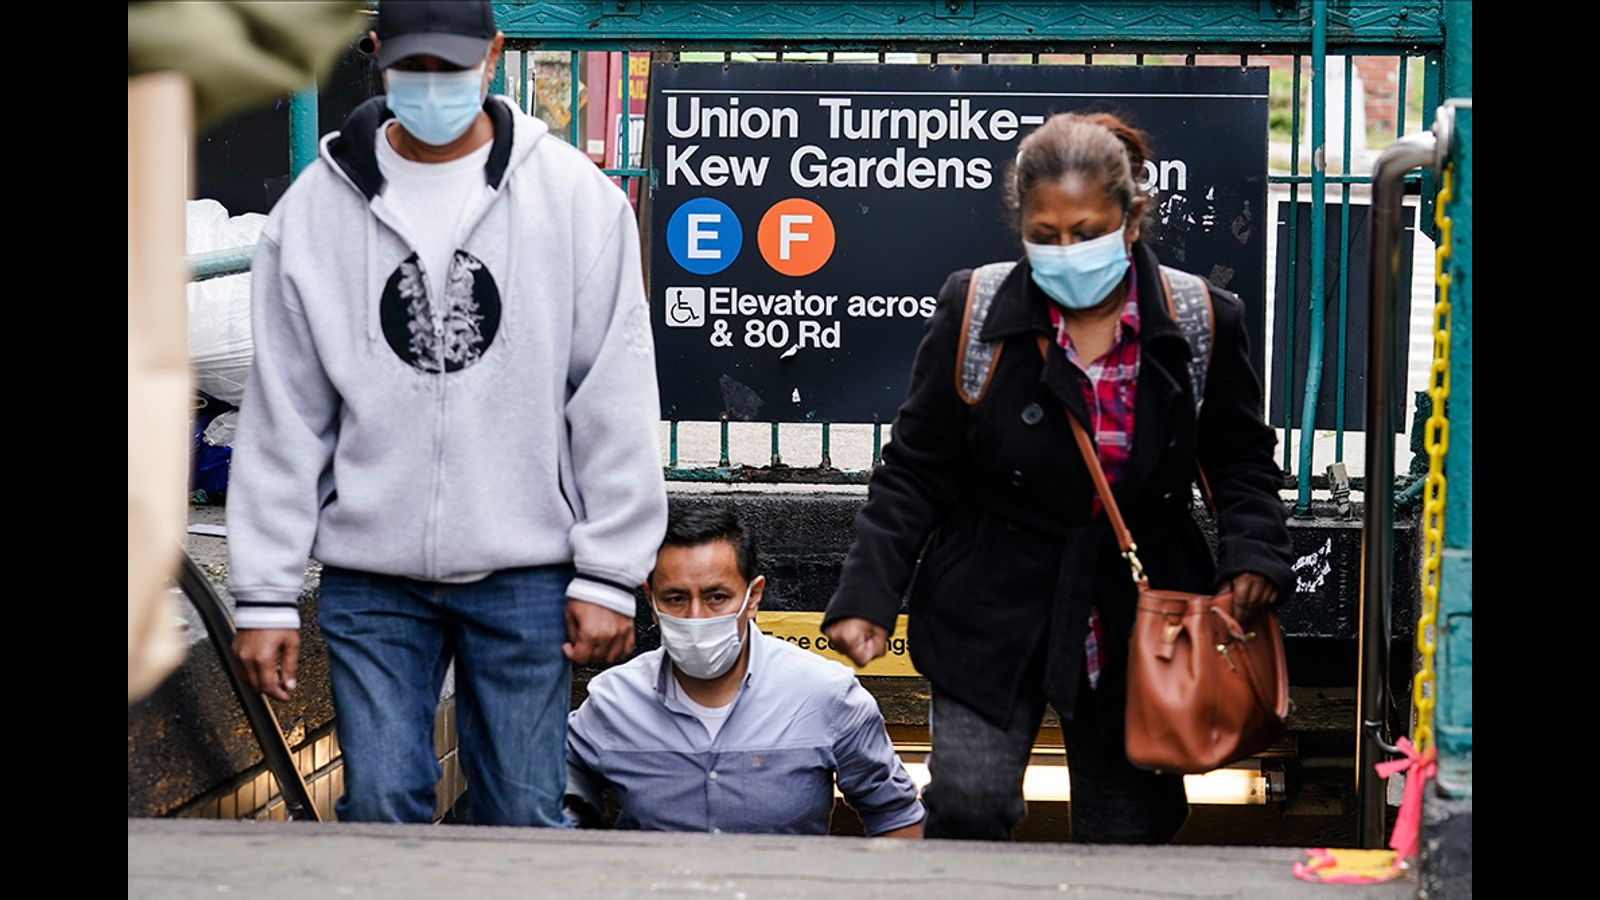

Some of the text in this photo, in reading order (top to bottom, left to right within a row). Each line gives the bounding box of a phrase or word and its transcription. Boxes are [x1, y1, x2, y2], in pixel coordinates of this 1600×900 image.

[667, 97, 1044, 148] Union Turnpike-
[666, 145, 992, 190] Kew Gardens
[687, 213, 722, 260] E
[779, 215, 813, 260] F
[709, 287, 937, 318] Elevator acros
[709, 319, 841, 348] & 80 Rd
